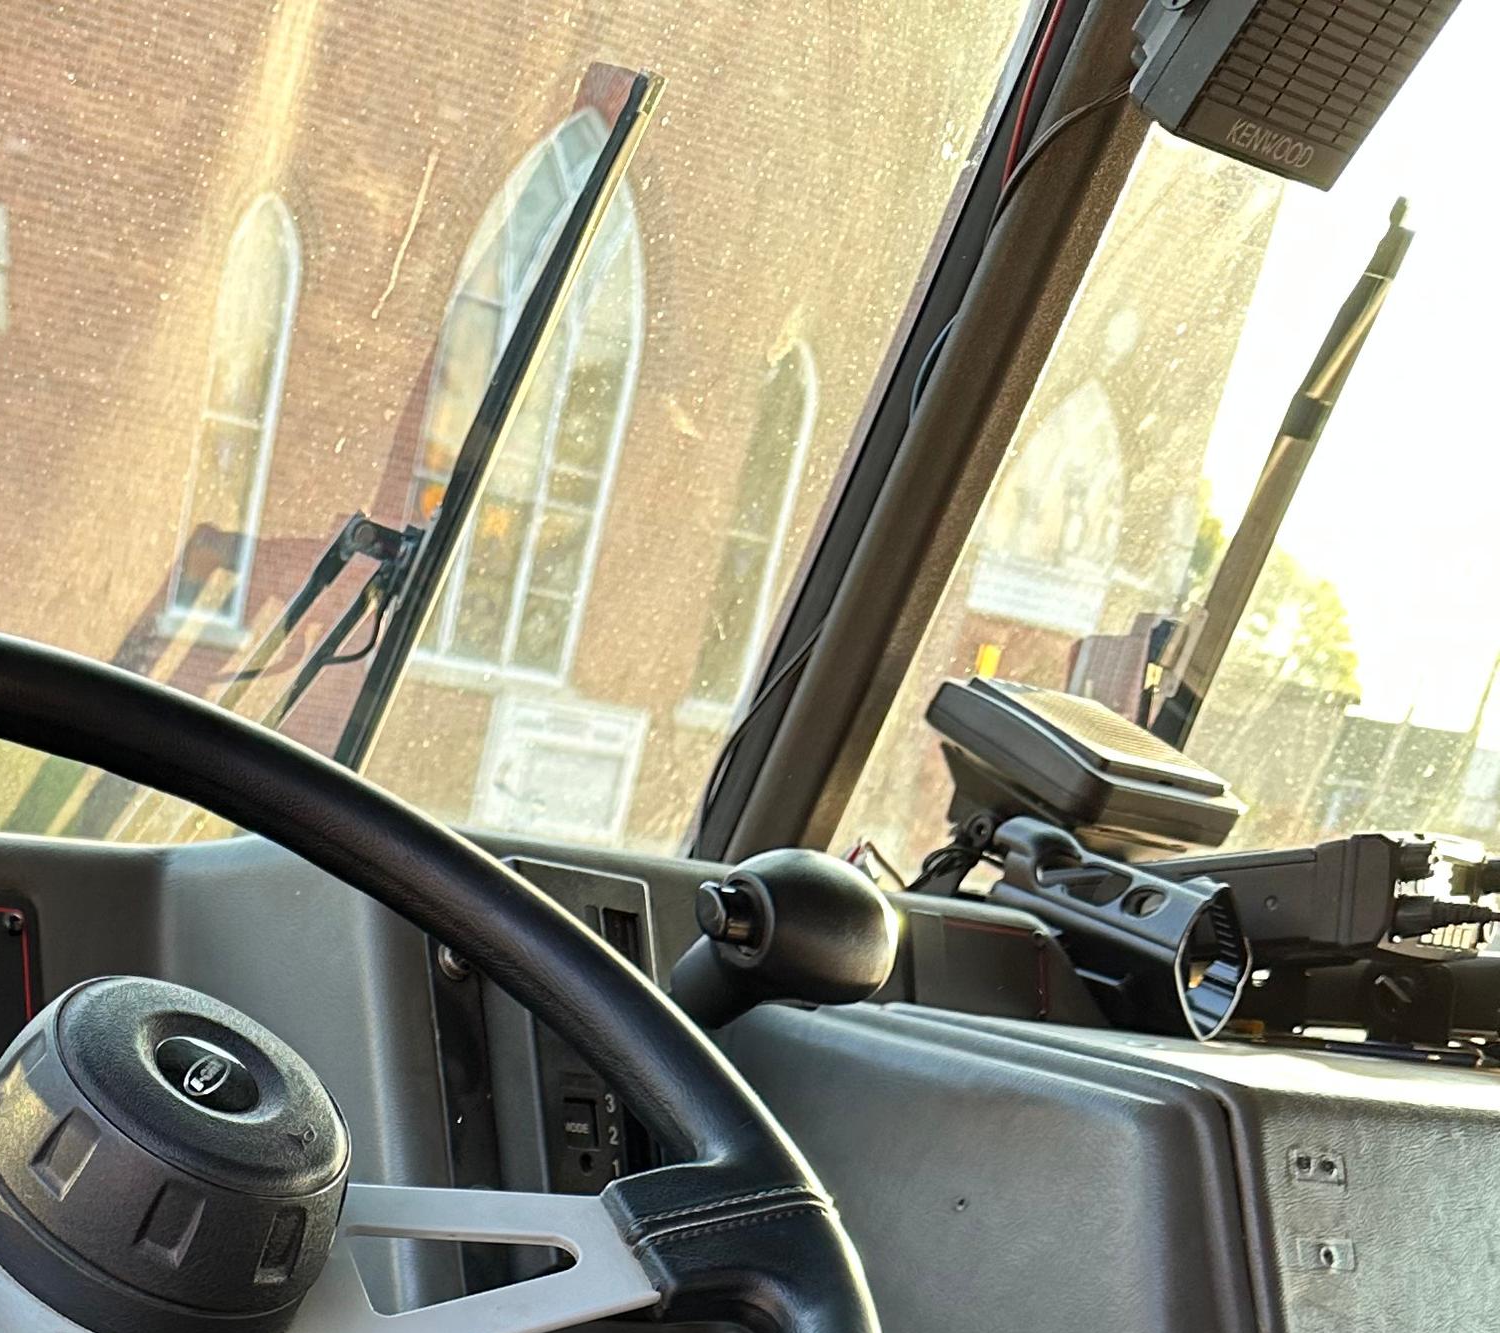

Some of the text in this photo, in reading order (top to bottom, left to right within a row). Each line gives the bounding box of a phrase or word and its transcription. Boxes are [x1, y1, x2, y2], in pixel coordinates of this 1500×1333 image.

[1226, 118, 1315, 168] KENWOOD
[604, 1093, 616, 1113] 3
[608, 1126, 620, 1146] 2
[612, 1159, 620, 1177] 1
